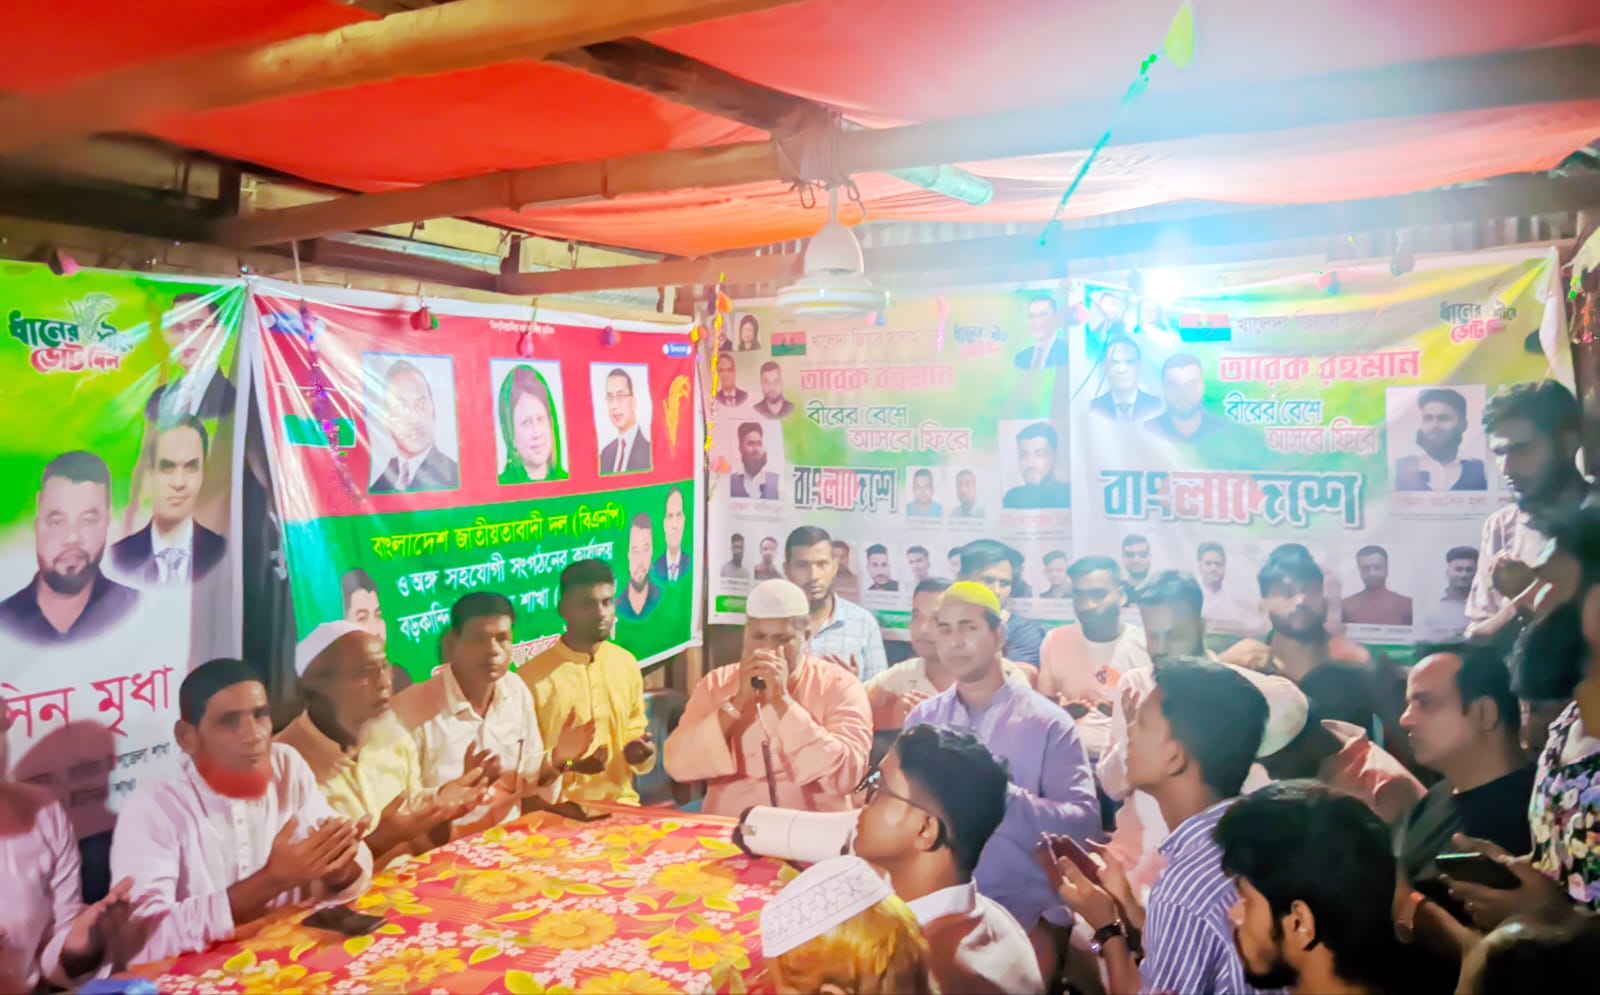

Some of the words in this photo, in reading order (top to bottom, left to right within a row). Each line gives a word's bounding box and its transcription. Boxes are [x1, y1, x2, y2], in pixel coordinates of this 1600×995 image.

[30, 343, 83, 373] ভোট
[1219, 355, 1310, 387] তারেক
[1318, 350, 1420, 387] রহমান
[807, 400, 858, 426] বীরের
[865, 406, 907, 425] বেশে
[1225, 390, 1276, 423] বীরের
[1281, 399, 1323, 423] বেশে
[849, 429, 912, 450] আসবে
[920, 421, 970, 451] ফিরে
[1265, 426, 1325, 451] আসবে
[1100, 470, 1361, 527] বাংলাদেশে
[371, 528, 449, 559] বাংলাদেশ
[452, 509, 543, 550] জাতীয়তাবাদী
[547, 514, 568, 536] দল
[444, 552, 505, 590] সহযোগী
[509, 544, 568, 578] সংগঠনের
[91, 664, 174, 738] মৃধা
